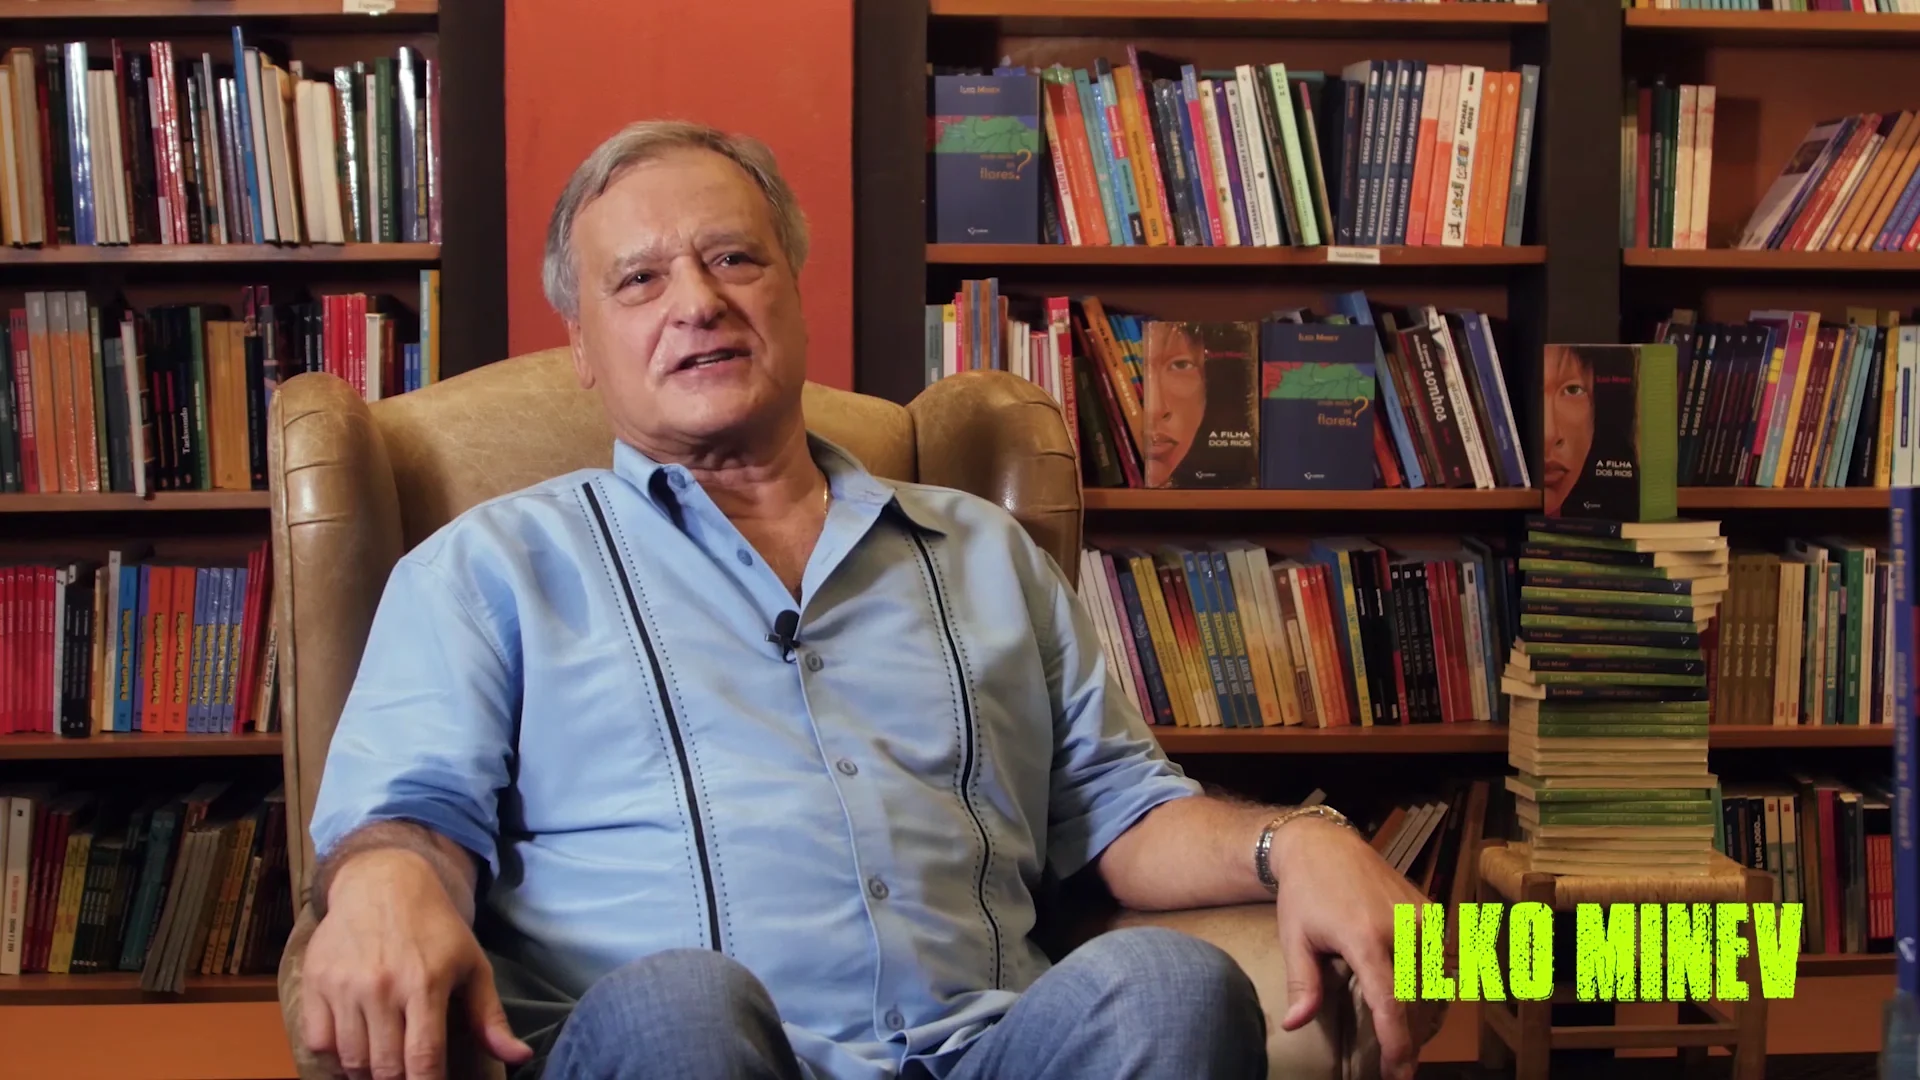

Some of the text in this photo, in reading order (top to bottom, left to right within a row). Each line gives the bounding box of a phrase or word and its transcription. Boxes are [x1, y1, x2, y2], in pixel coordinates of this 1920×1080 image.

[1460, 100, 1469, 135] MICHAEL
[1467, 107, 1475, 129] MOSS
[1063, 355, 1073, 399] NATURAL
[1424, 370, 1447, 422] sonhos
[1457, 404, 1464, 415] do
[179, 407, 190, 455] Taekwondo
[1220, 431, 1250, 439] FILHA
[1460, 416, 1472, 442] Mapas
[1209, 439, 1229, 447] DOS
[1606, 460, 1632, 468] FILHA
[1756, 847, 1763, 862] UM
